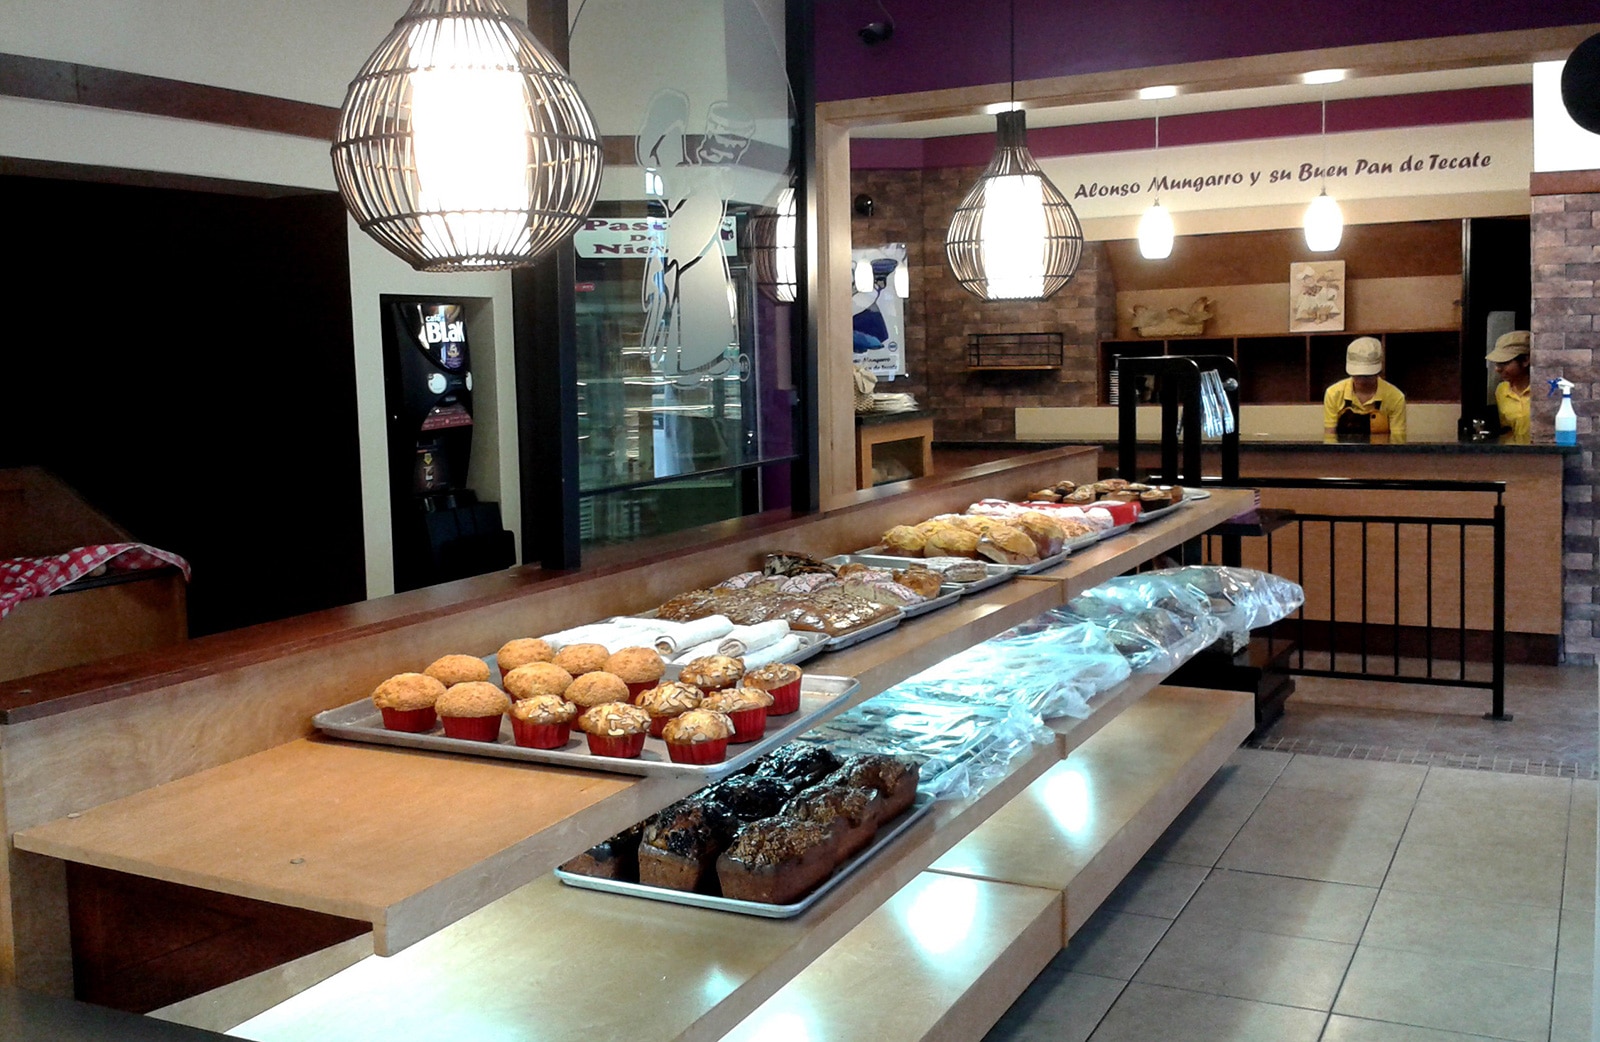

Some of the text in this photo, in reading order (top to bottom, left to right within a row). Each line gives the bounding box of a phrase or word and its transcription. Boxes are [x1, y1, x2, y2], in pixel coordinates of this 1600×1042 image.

[1074, 152, 1491, 200] Alonso Mungarro y su Buen Pan de Tecate
